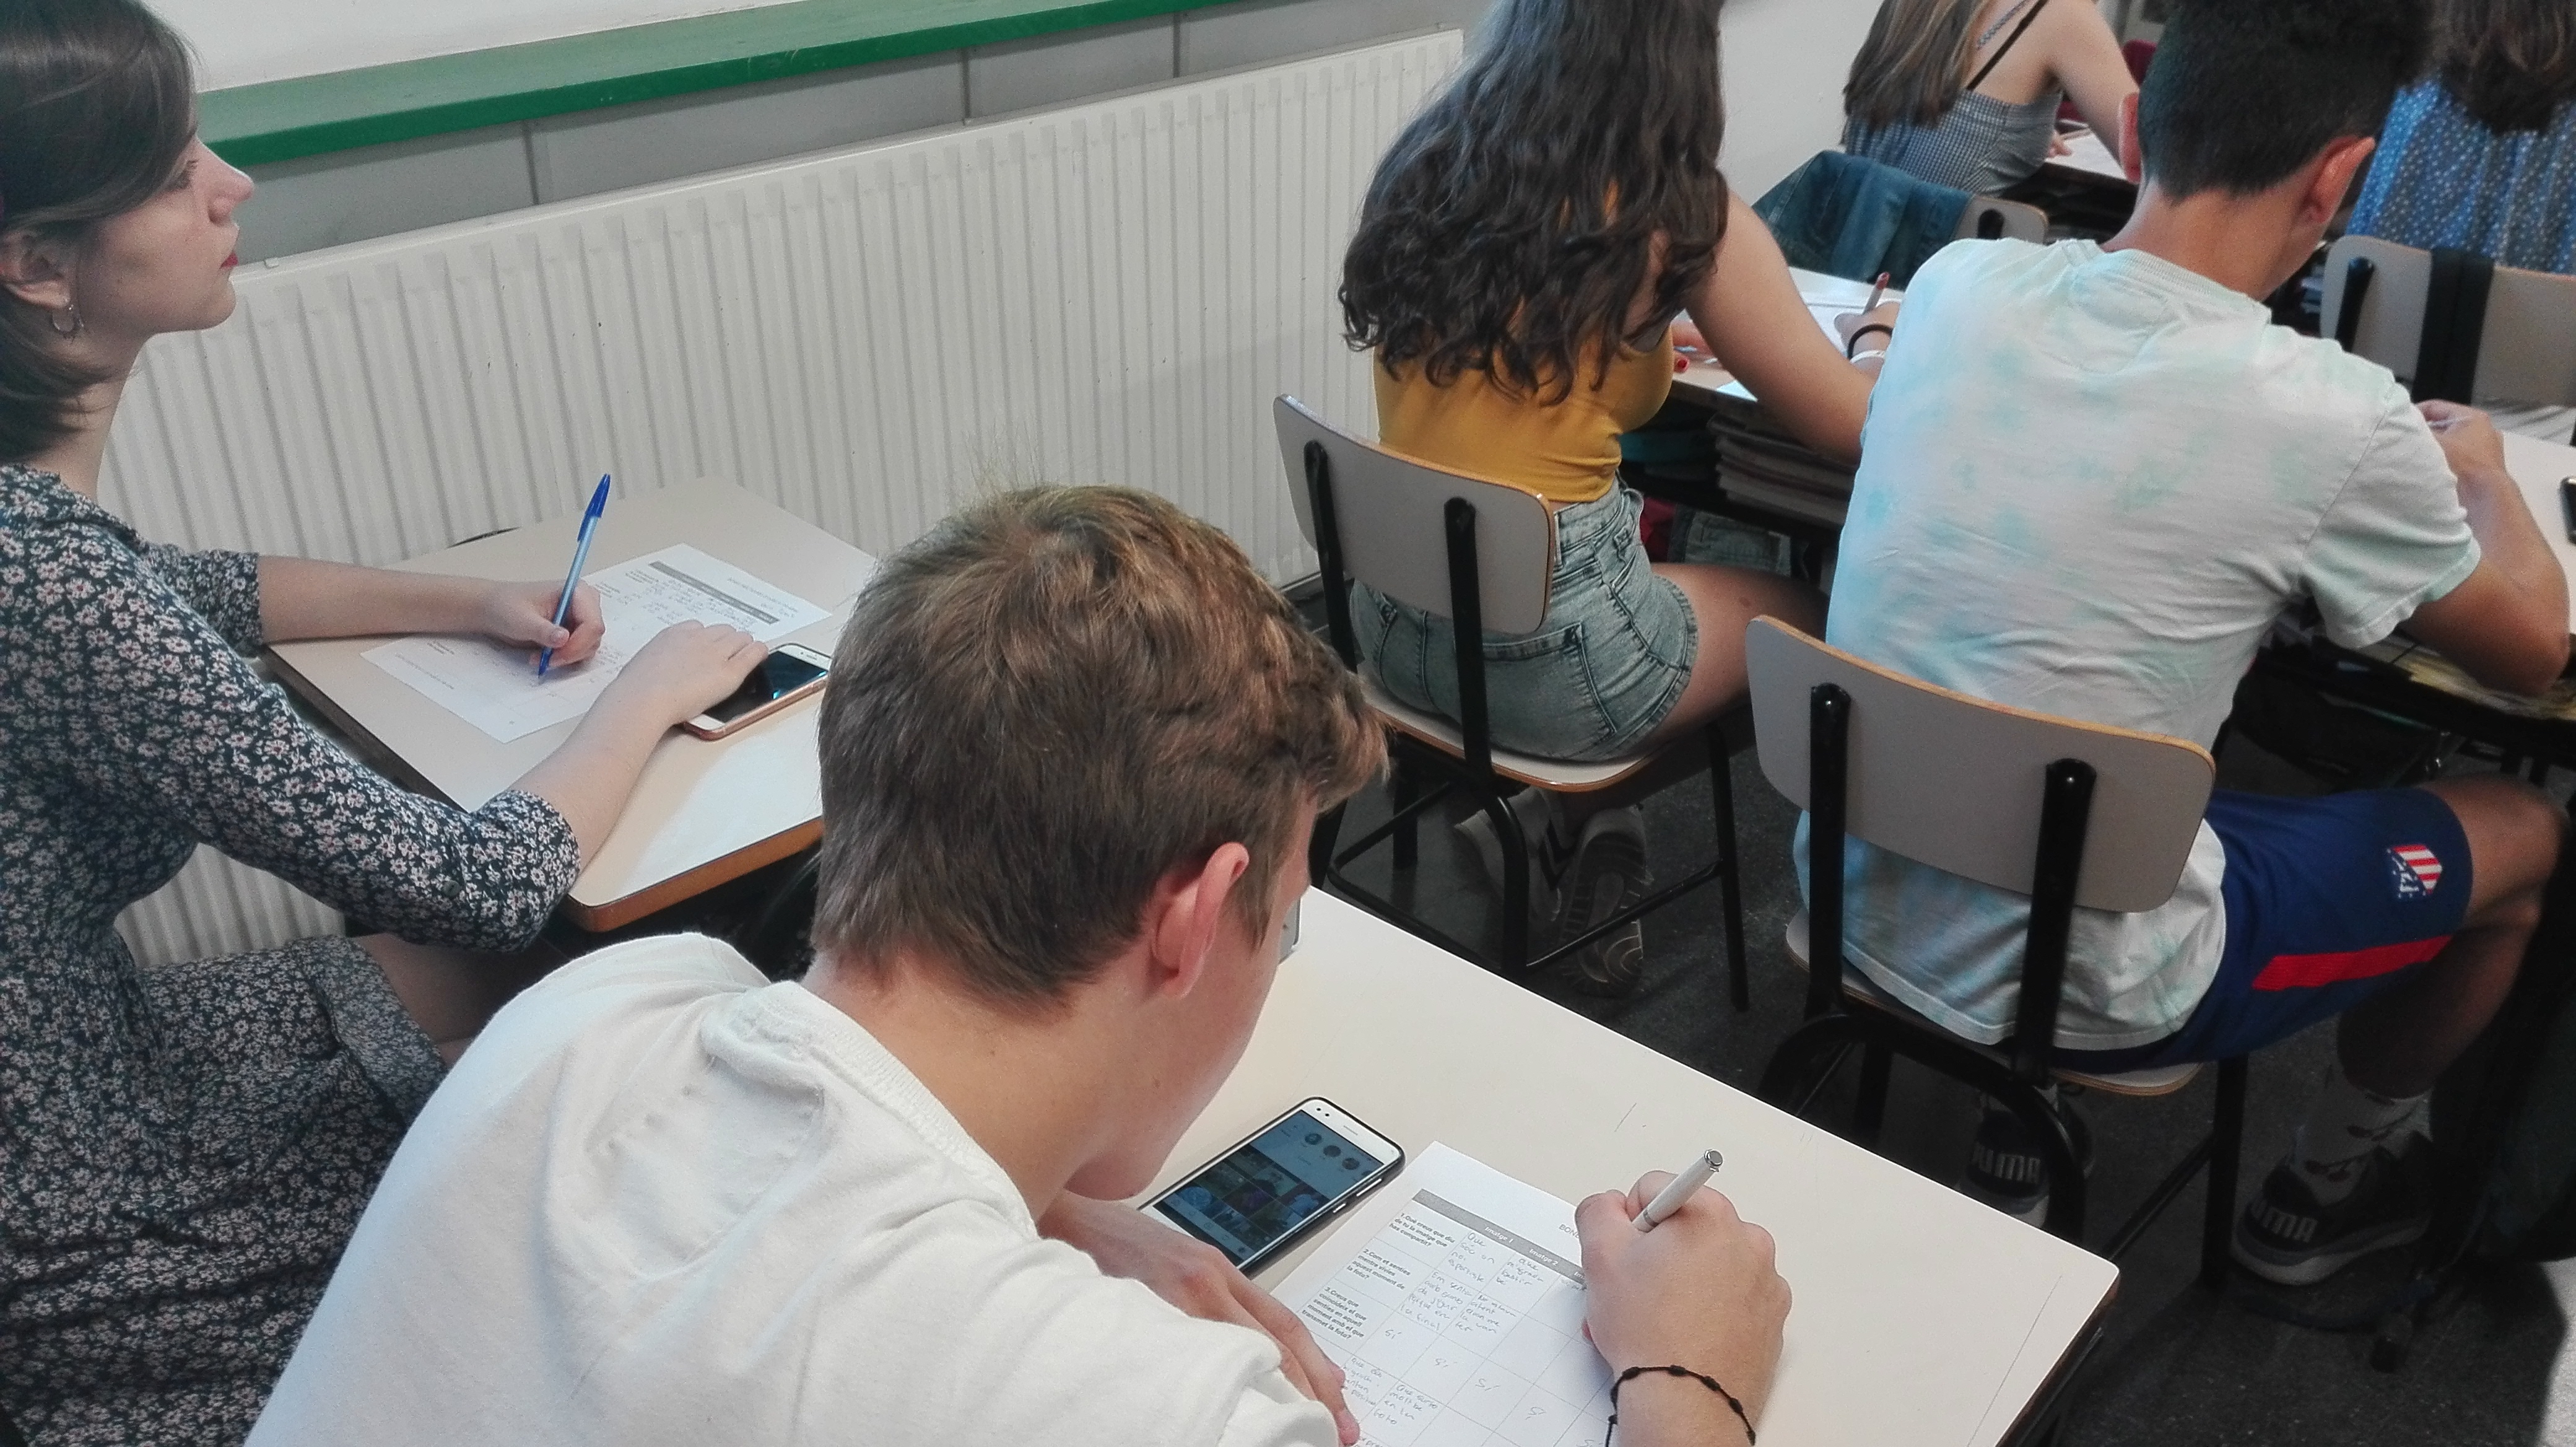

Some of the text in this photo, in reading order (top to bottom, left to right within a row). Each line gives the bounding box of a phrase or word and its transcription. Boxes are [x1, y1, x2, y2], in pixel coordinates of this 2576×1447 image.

[1389, 1223, 1432, 1246] has compartit?
[1416, 1229, 1435, 1241] imatge
[1417, 1222, 1433, 1232] creus
[1433, 1230, 1445, 1238] que
[1484, 1226, 1508, 1243] Imatge
[1358, 1255, 1395, 1276] mentre vivies
[1363, 1249, 1382, 1261] 2.Com
[1389, 1263, 1411, 1275] senties
[1529, 1248, 1552, 1264] Imatge
[1352, 1261, 1372, 1272] aquest
[1372, 1271, 1396, 1285] moment
[1353, 1269, 1369, 1279] foto?
[1319, 1293, 1348, 1311] coincideix
[1355, 1313, 1367, 1321] que
[1324, 1287, 1359, 1308] 3.Creus que
[1302, 1309, 1328, 1327] transmet
[1334, 1327, 1351, 1339] foto?
[1307, 1304, 1332, 1320] moment
[1331, 1319, 1345, 1327] amb
[1352, 1329, 1364, 1337] que
[1313, 1299, 1334, 1313] senties
[1342, 1315, 1362, 1327] aquell
